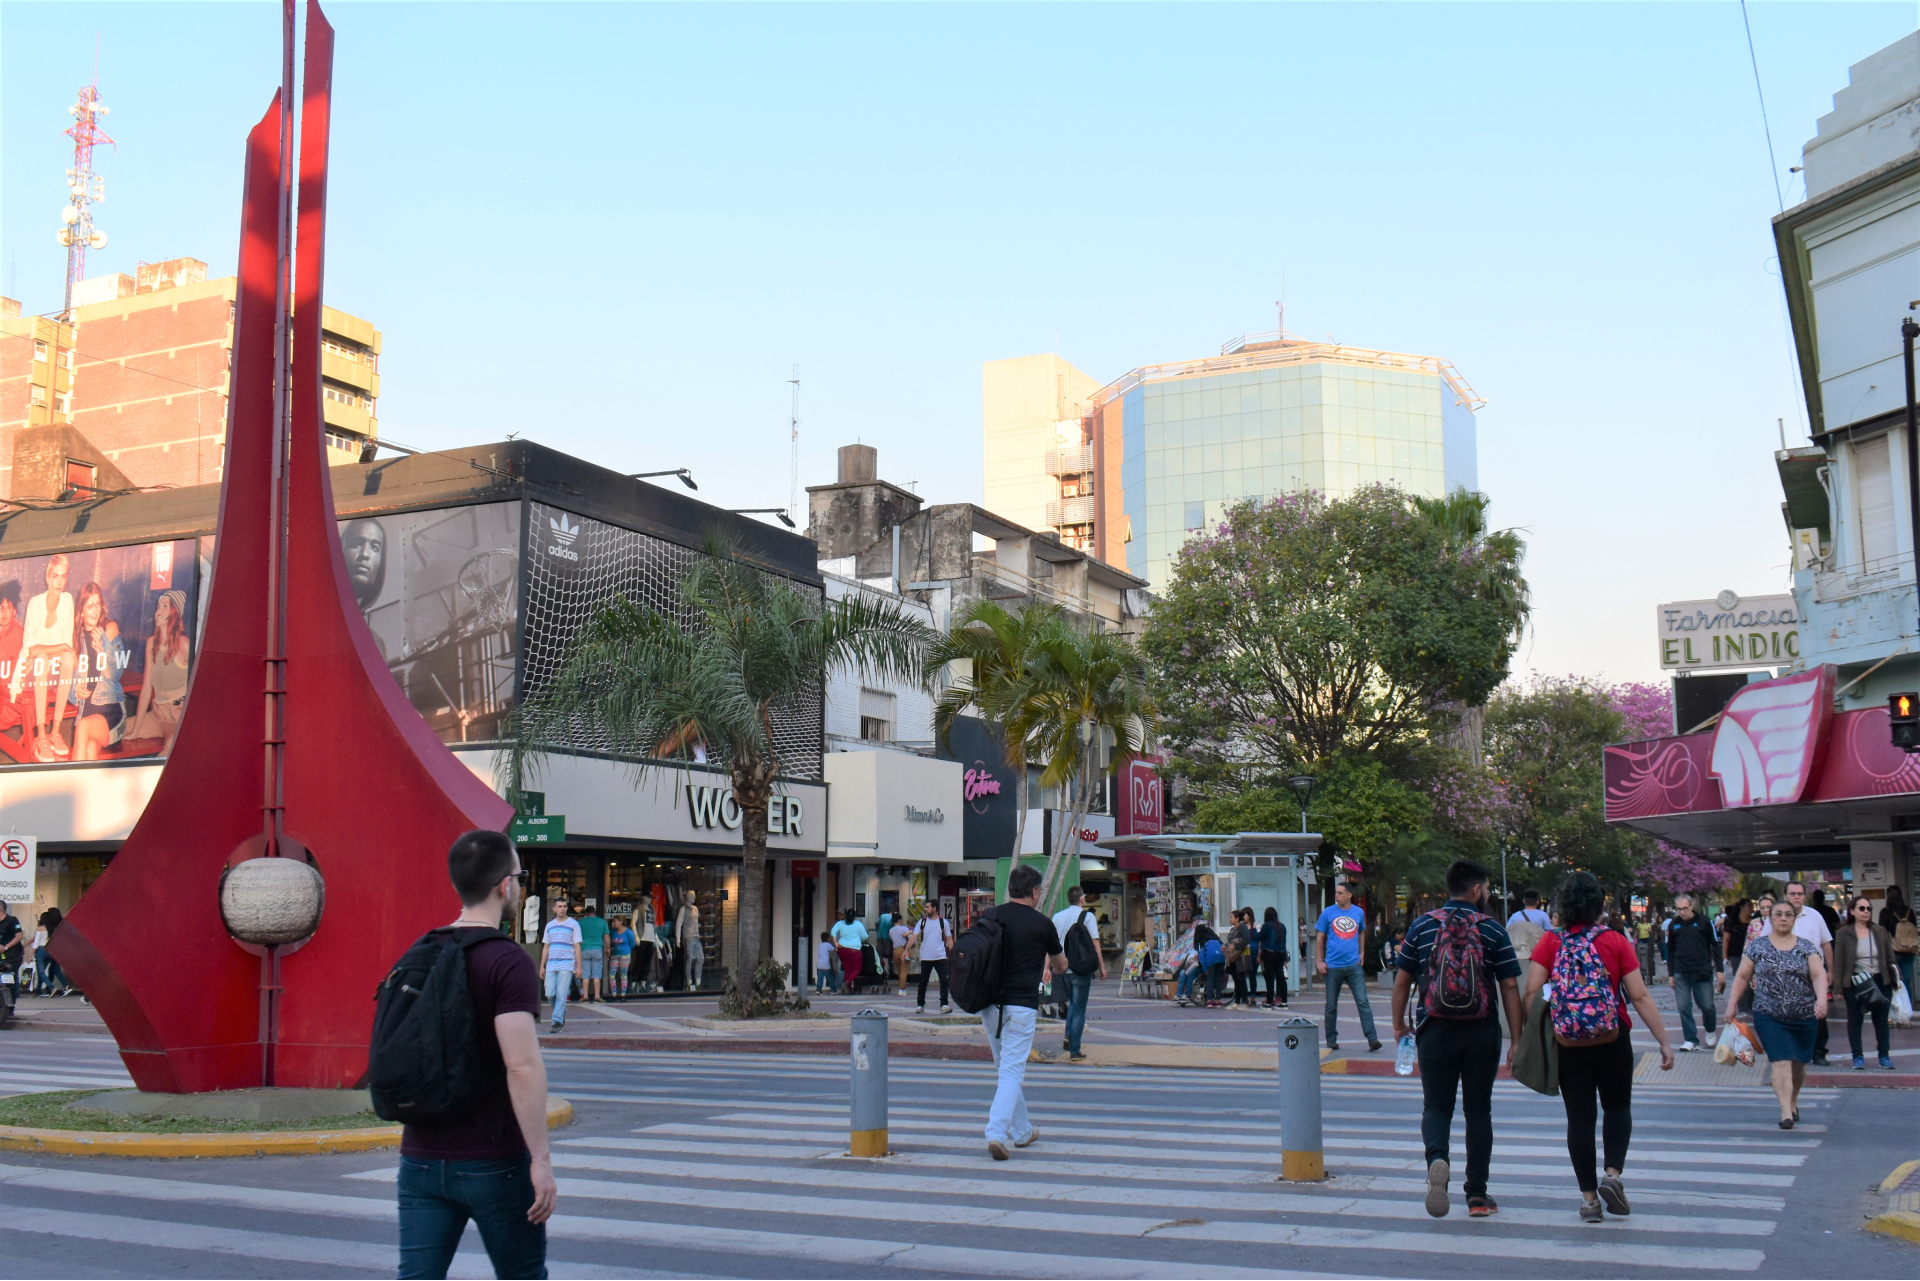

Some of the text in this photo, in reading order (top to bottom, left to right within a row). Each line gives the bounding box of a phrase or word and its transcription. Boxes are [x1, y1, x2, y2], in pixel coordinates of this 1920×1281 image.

[548, 545, 578, 561] adidas
[1663, 608, 1797, 632] Farmacia
[1662, 637, 1701, 665] EL
[78, 650, 131, 673] BOW
[686, 785, 803, 836] WOER
[536, 834, 548, 842] 300
[606, 903, 632, 913] WOKER
[943, 902, 953, 920] 12
